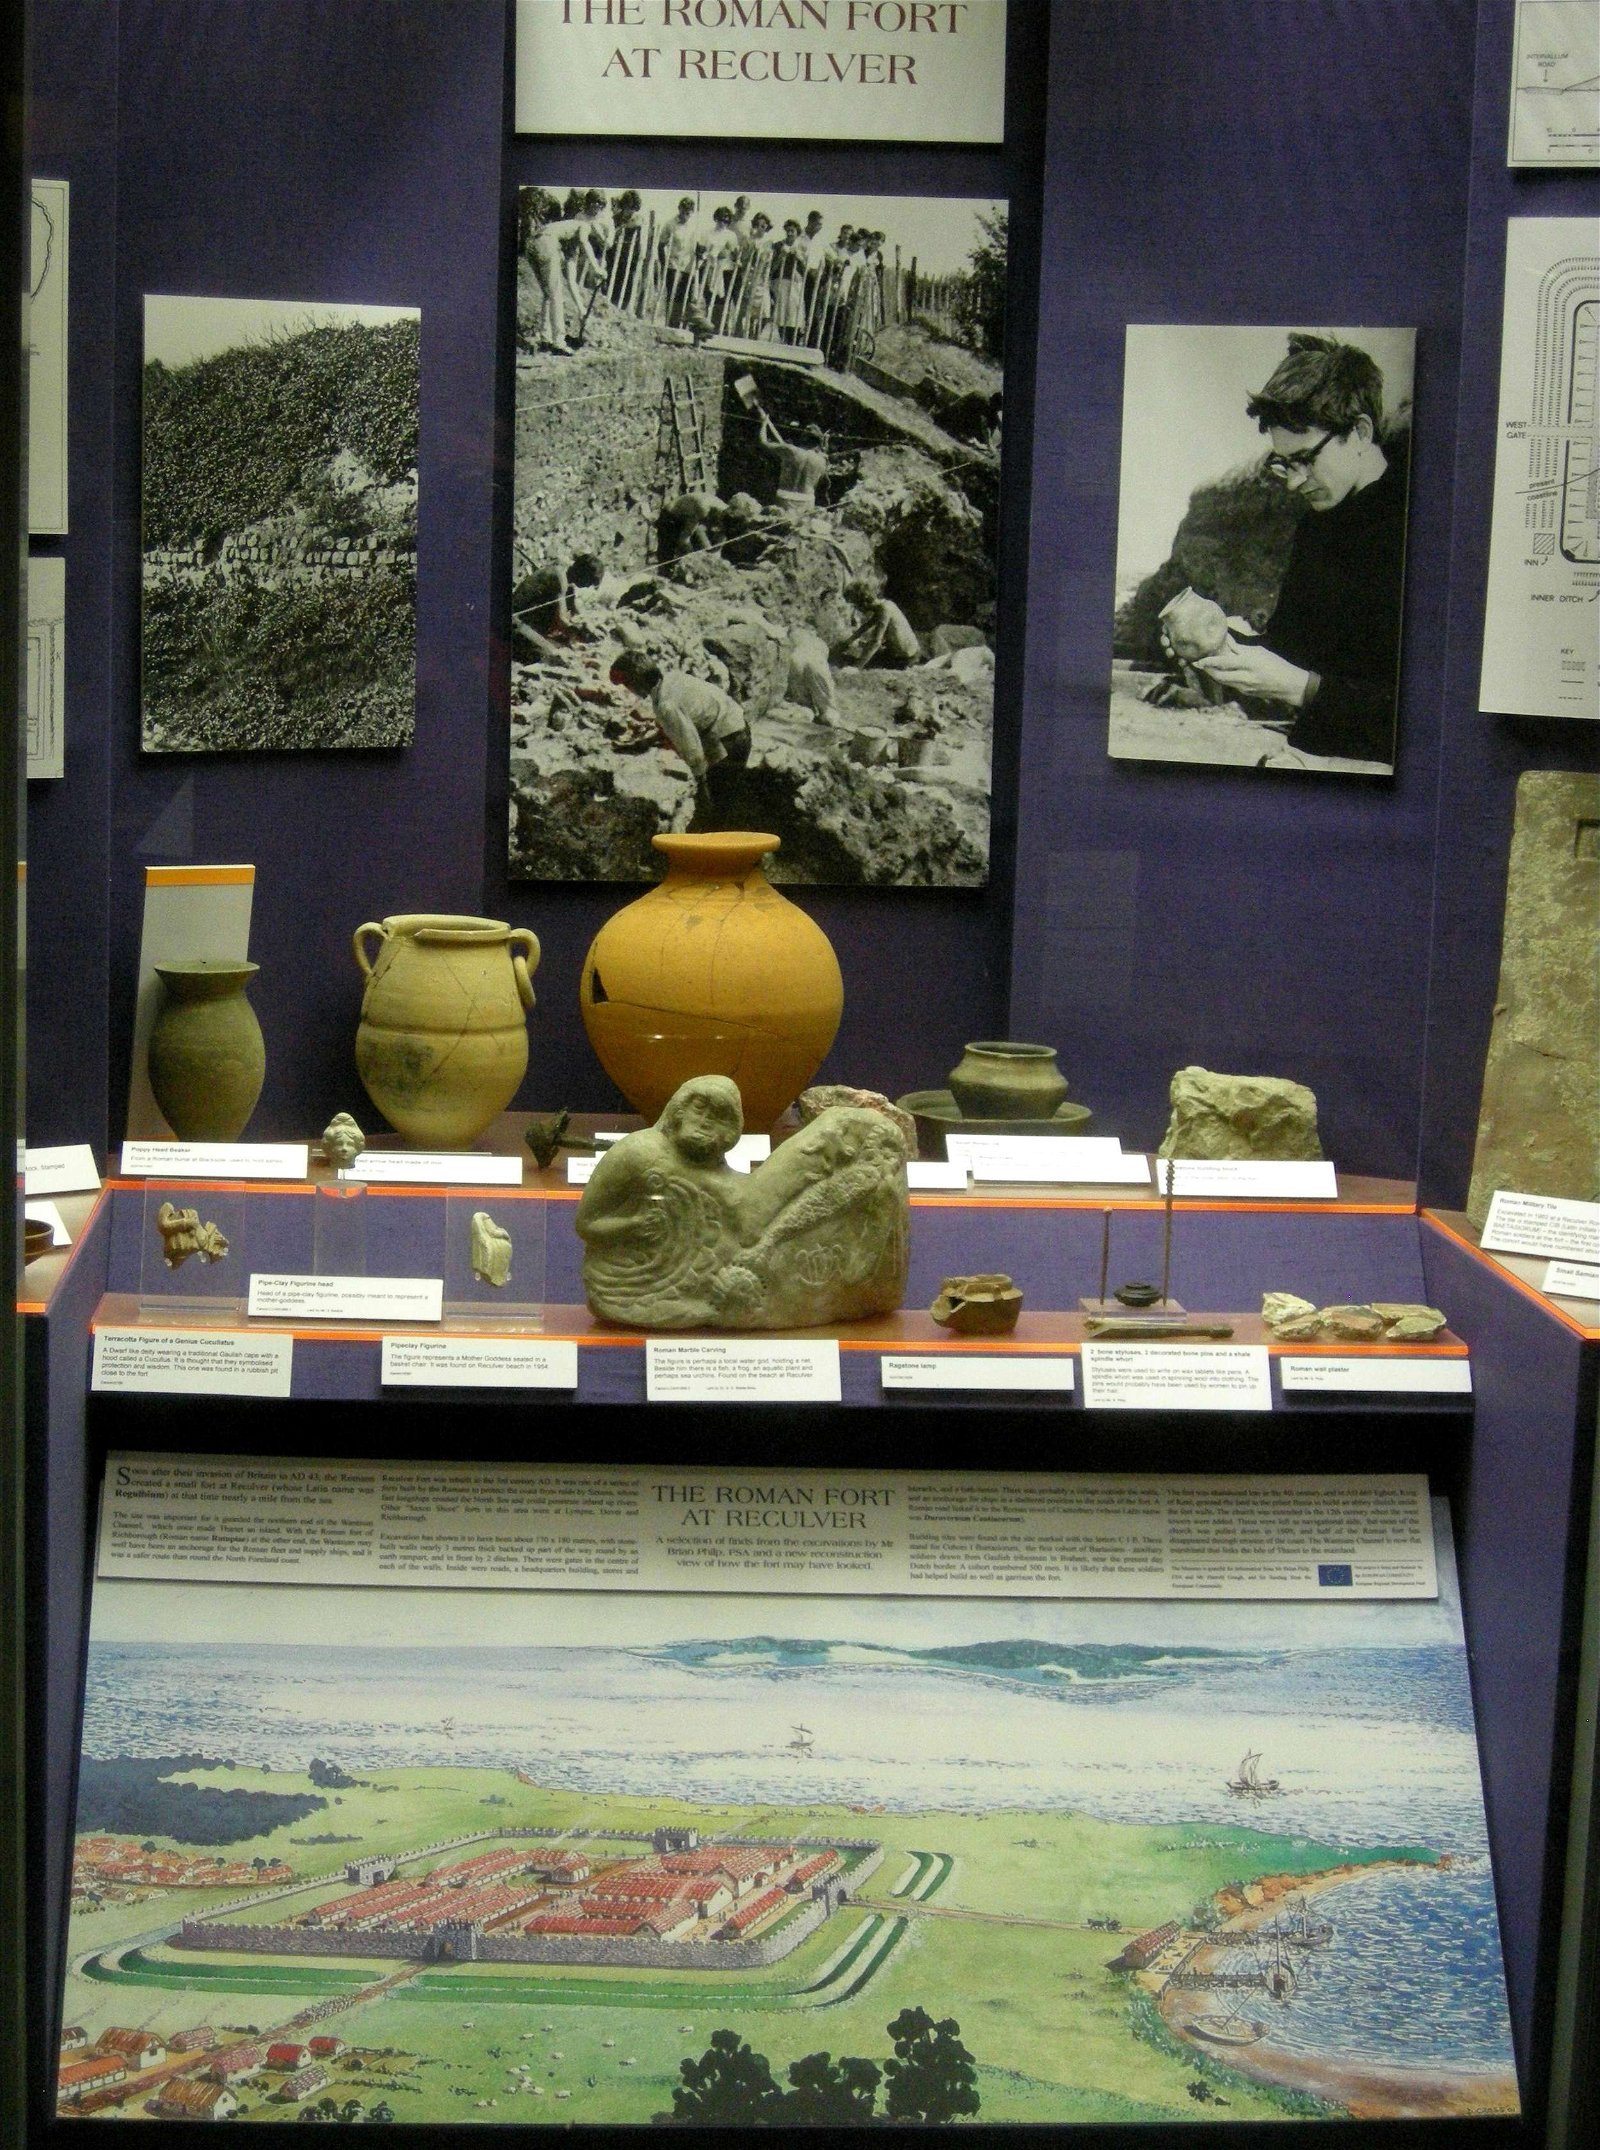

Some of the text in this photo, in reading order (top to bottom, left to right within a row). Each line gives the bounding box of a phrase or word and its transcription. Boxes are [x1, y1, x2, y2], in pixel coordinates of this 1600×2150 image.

[560, 0, 968, 34] THE ROMAN FORT
[601, 47, 918, 86] AT RECULVER
[1505, 421, 1527, 429] WEST
[1528, 478, 1556, 490] present
[1526, 490, 1558, 502] coastline
[1530, 594, 1584, 603] INNER DITCH
[1522, 1200, 1545, 1209] Military
[258, 1279, 289, 1288] Pipe-Clay
[290, 1280, 316, 1288] Figurine
[139, 1336, 160, 1345] Figure
[390, 1342, 447, 1351] Pipeclay Figurine
[141, 1348, 155, 1356] deity
[157, 1348, 181, 1357] wearing
[186, 1357, 209, 1366] thought
[403, 1354, 421, 1362] figure
[422, 1354, 455, 1363] represents
[102, 1363, 132, 1371] protection
[889, 1362, 919, 1370] Ragstone
[1328, 1366, 1350, 1374] plaster
[650, 1485, 897, 1507] THE ROMAN FORT
[681, 1509, 867, 1529] AT RECULVER
[667, 1537, 712, 1545] selection
[757, 1538, 780, 1546] from
[803, 1539, 862, 1547] excavations
[865, 1540, 877, 1549] by
[667, 1548, 694, 1556] Brian
[753, 1549, 773, 1557] and
[810, 1550, 882, 1558] reconstruction
[676, 1559, 700, 1567] view
[744, 1560, 760, 1568] the
[783, 1562, 804, 1570] may
[808, 1561, 833, 1569] have
